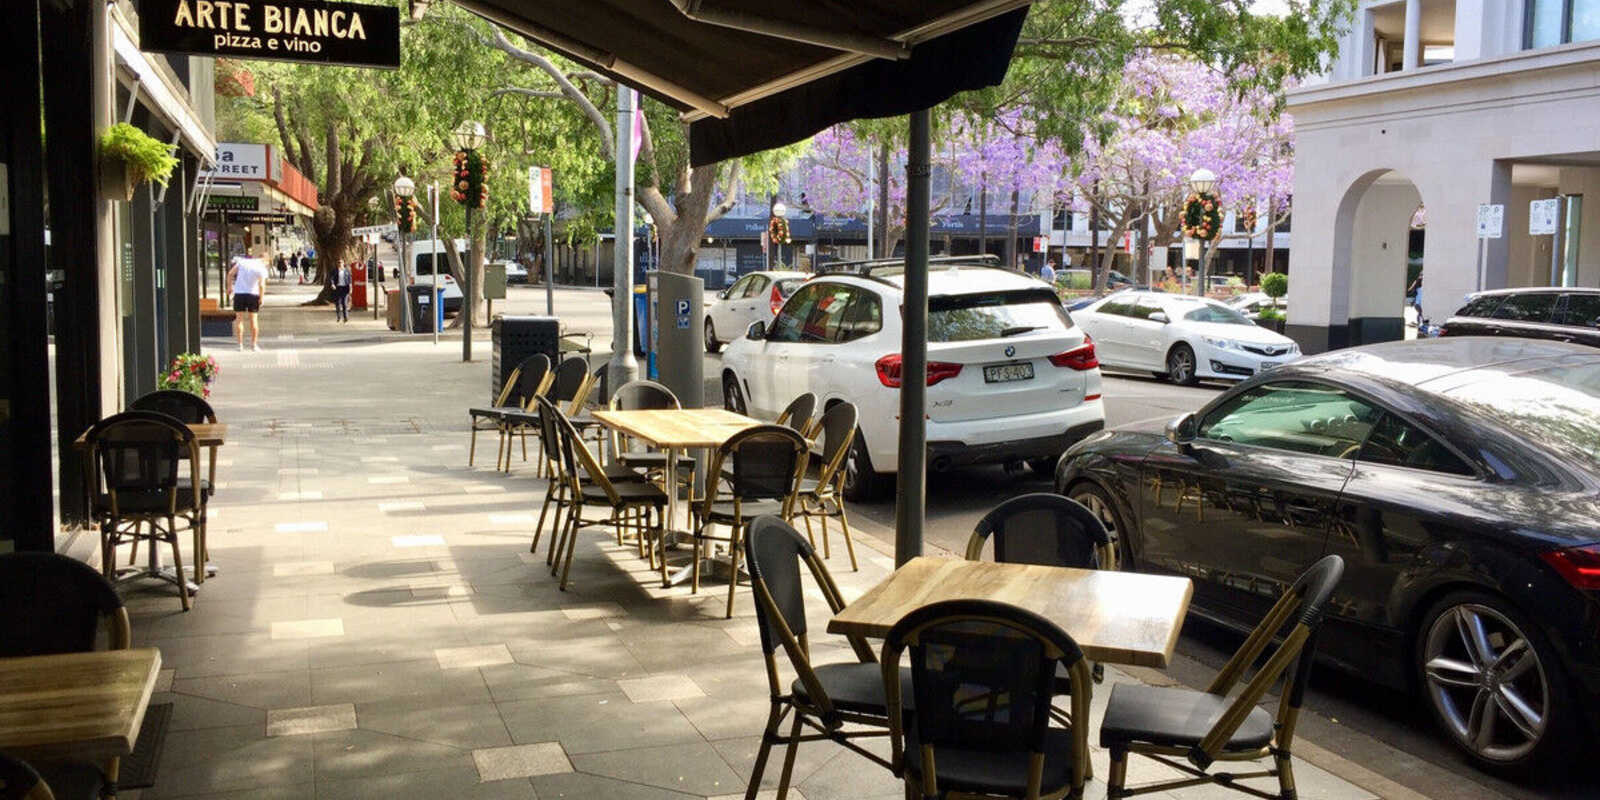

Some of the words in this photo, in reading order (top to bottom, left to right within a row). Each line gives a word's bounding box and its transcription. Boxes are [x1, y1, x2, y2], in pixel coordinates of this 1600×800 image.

[174, 0, 251, 31] ARTE
[263, 5, 367, 40] BIANCA
[214, 33, 262, 50] pizza
[267, 38, 279, 50] e
[283, 38, 322, 53] vino
[679, 301, 688, 314] P
